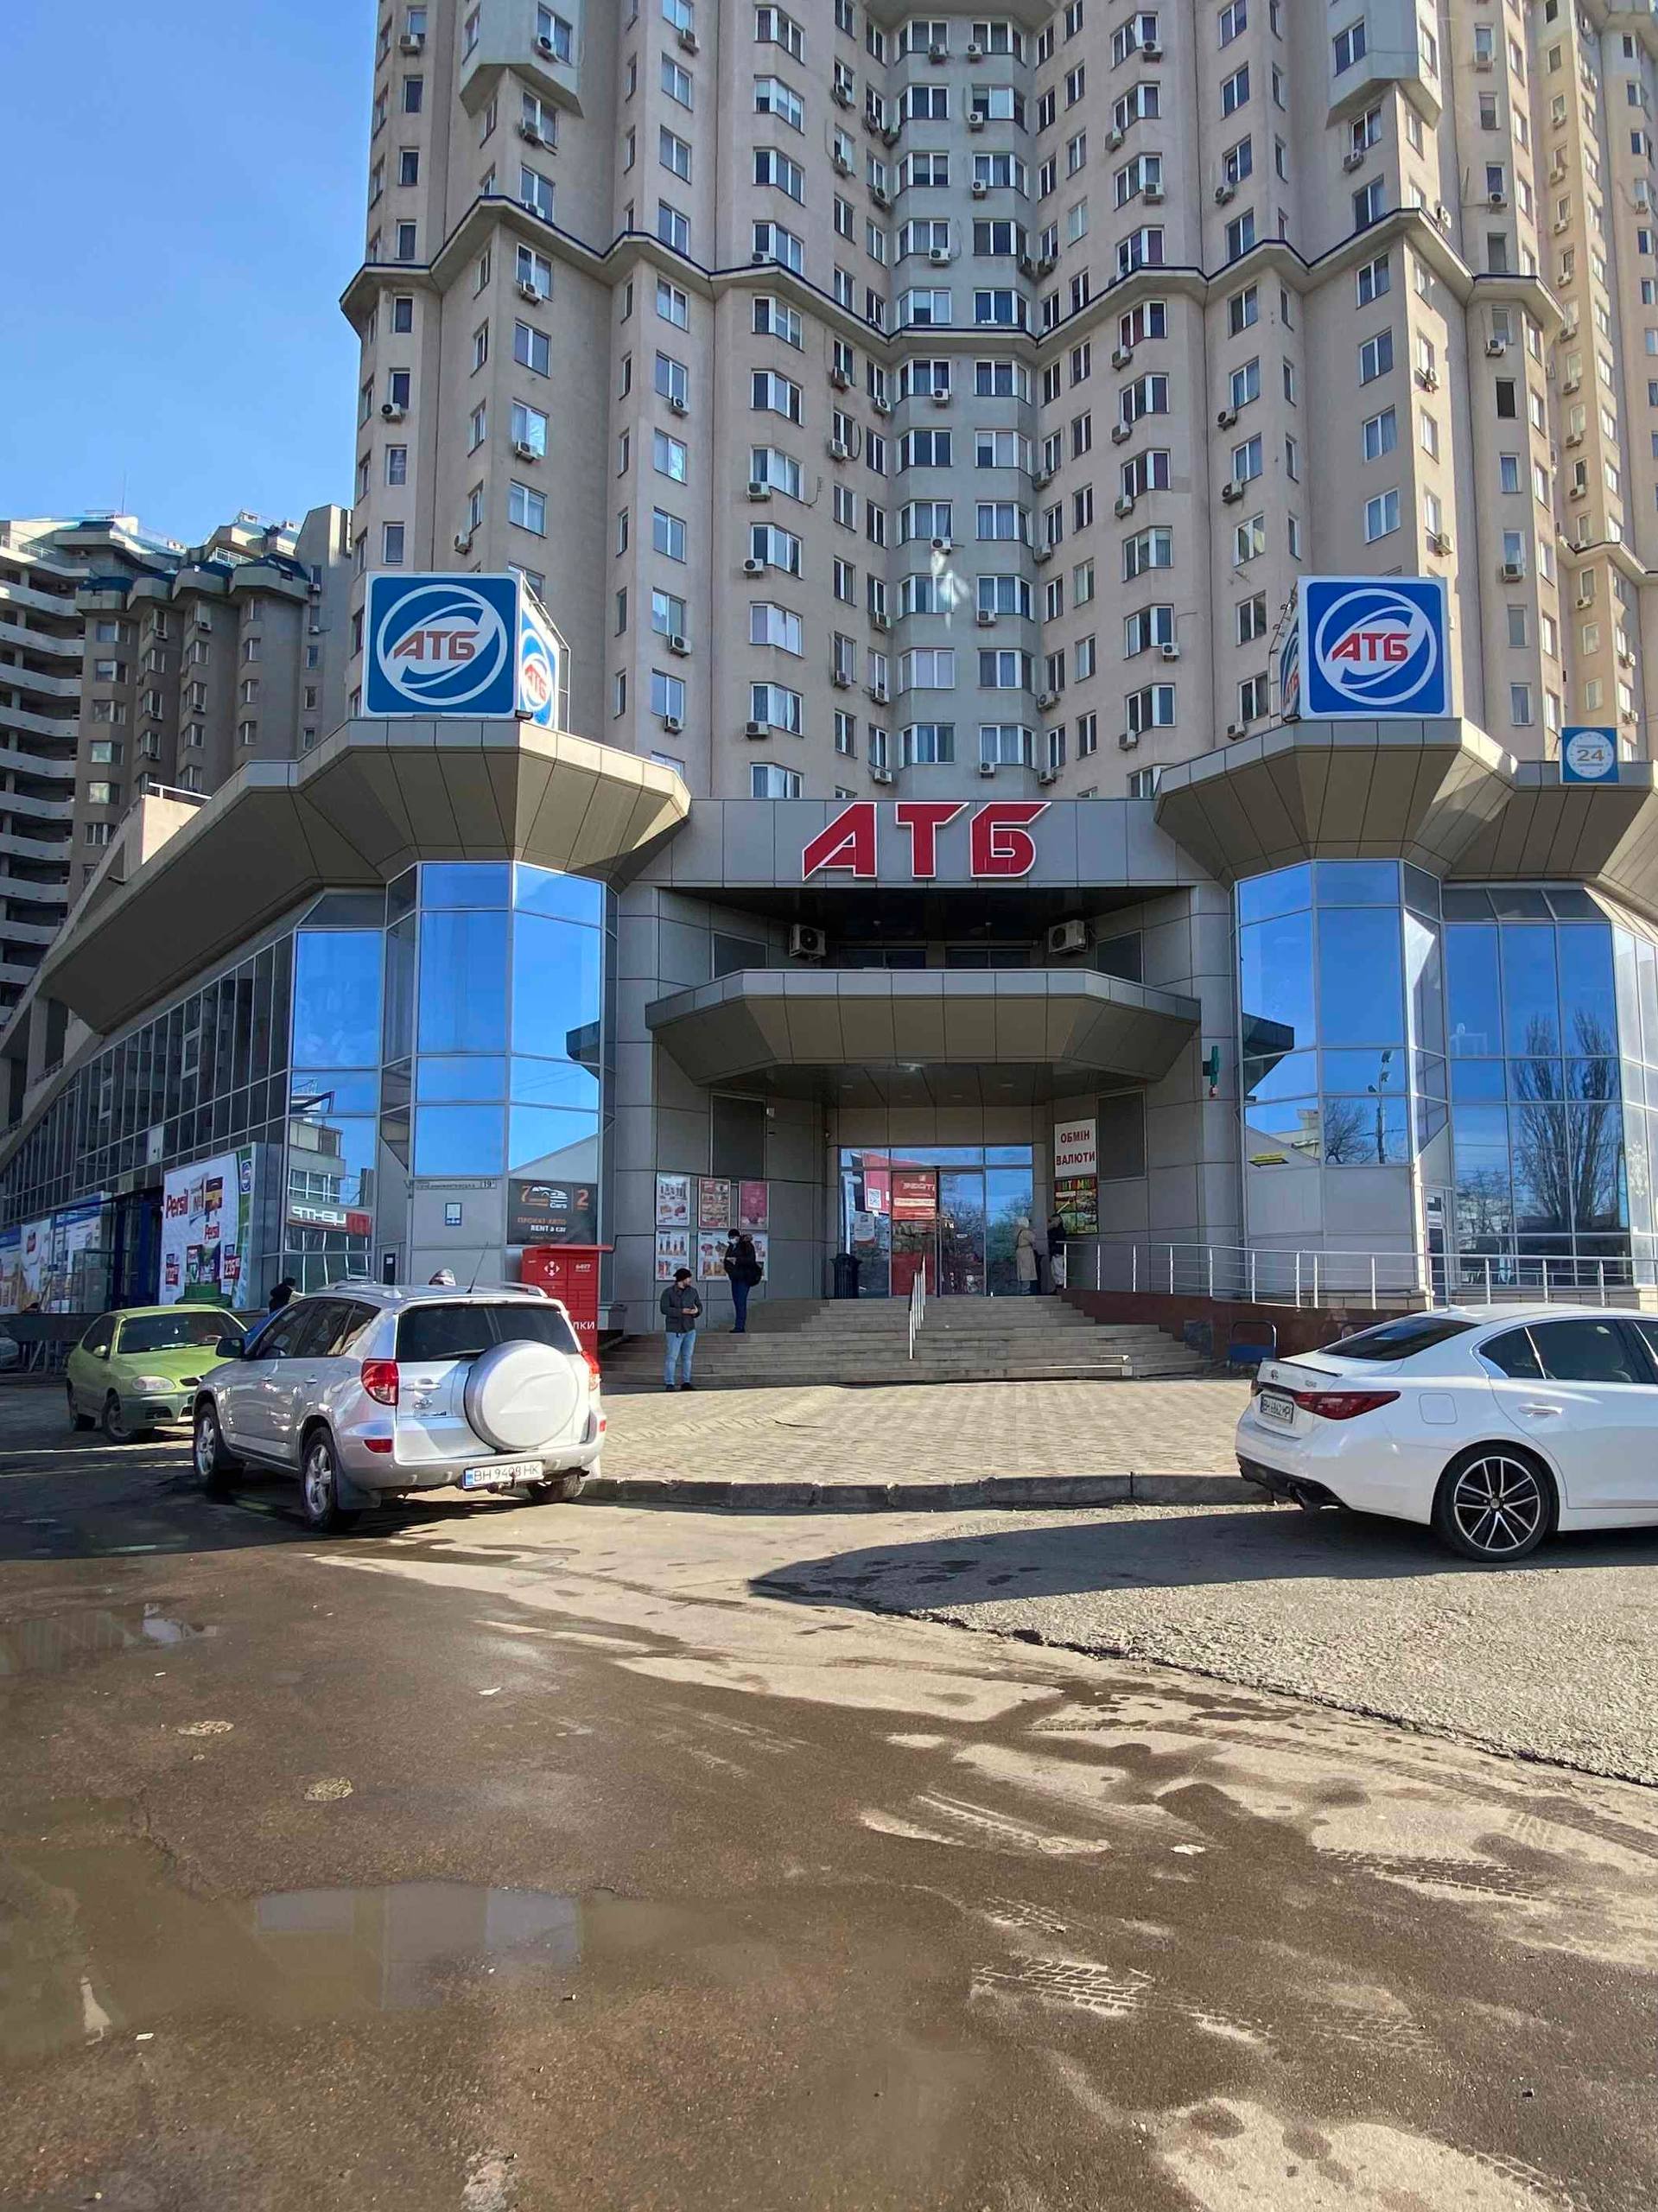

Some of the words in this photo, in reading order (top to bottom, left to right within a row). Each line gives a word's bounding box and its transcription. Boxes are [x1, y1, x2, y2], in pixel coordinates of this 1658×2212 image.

[393, 631, 480, 660] АТБ
[1331, 632, 1412, 662] АТБ
[524, 664, 547, 702] АТБ
[1577, 749, 1604, 761] 24
[802, 801, 1052, 881] АТБ
[1060, 1129, 1090, 1143] ОБМІН
[1056, 1152, 1096, 1166] ВАЛЮТИ
[474, 1470, 492, 1482] BH
